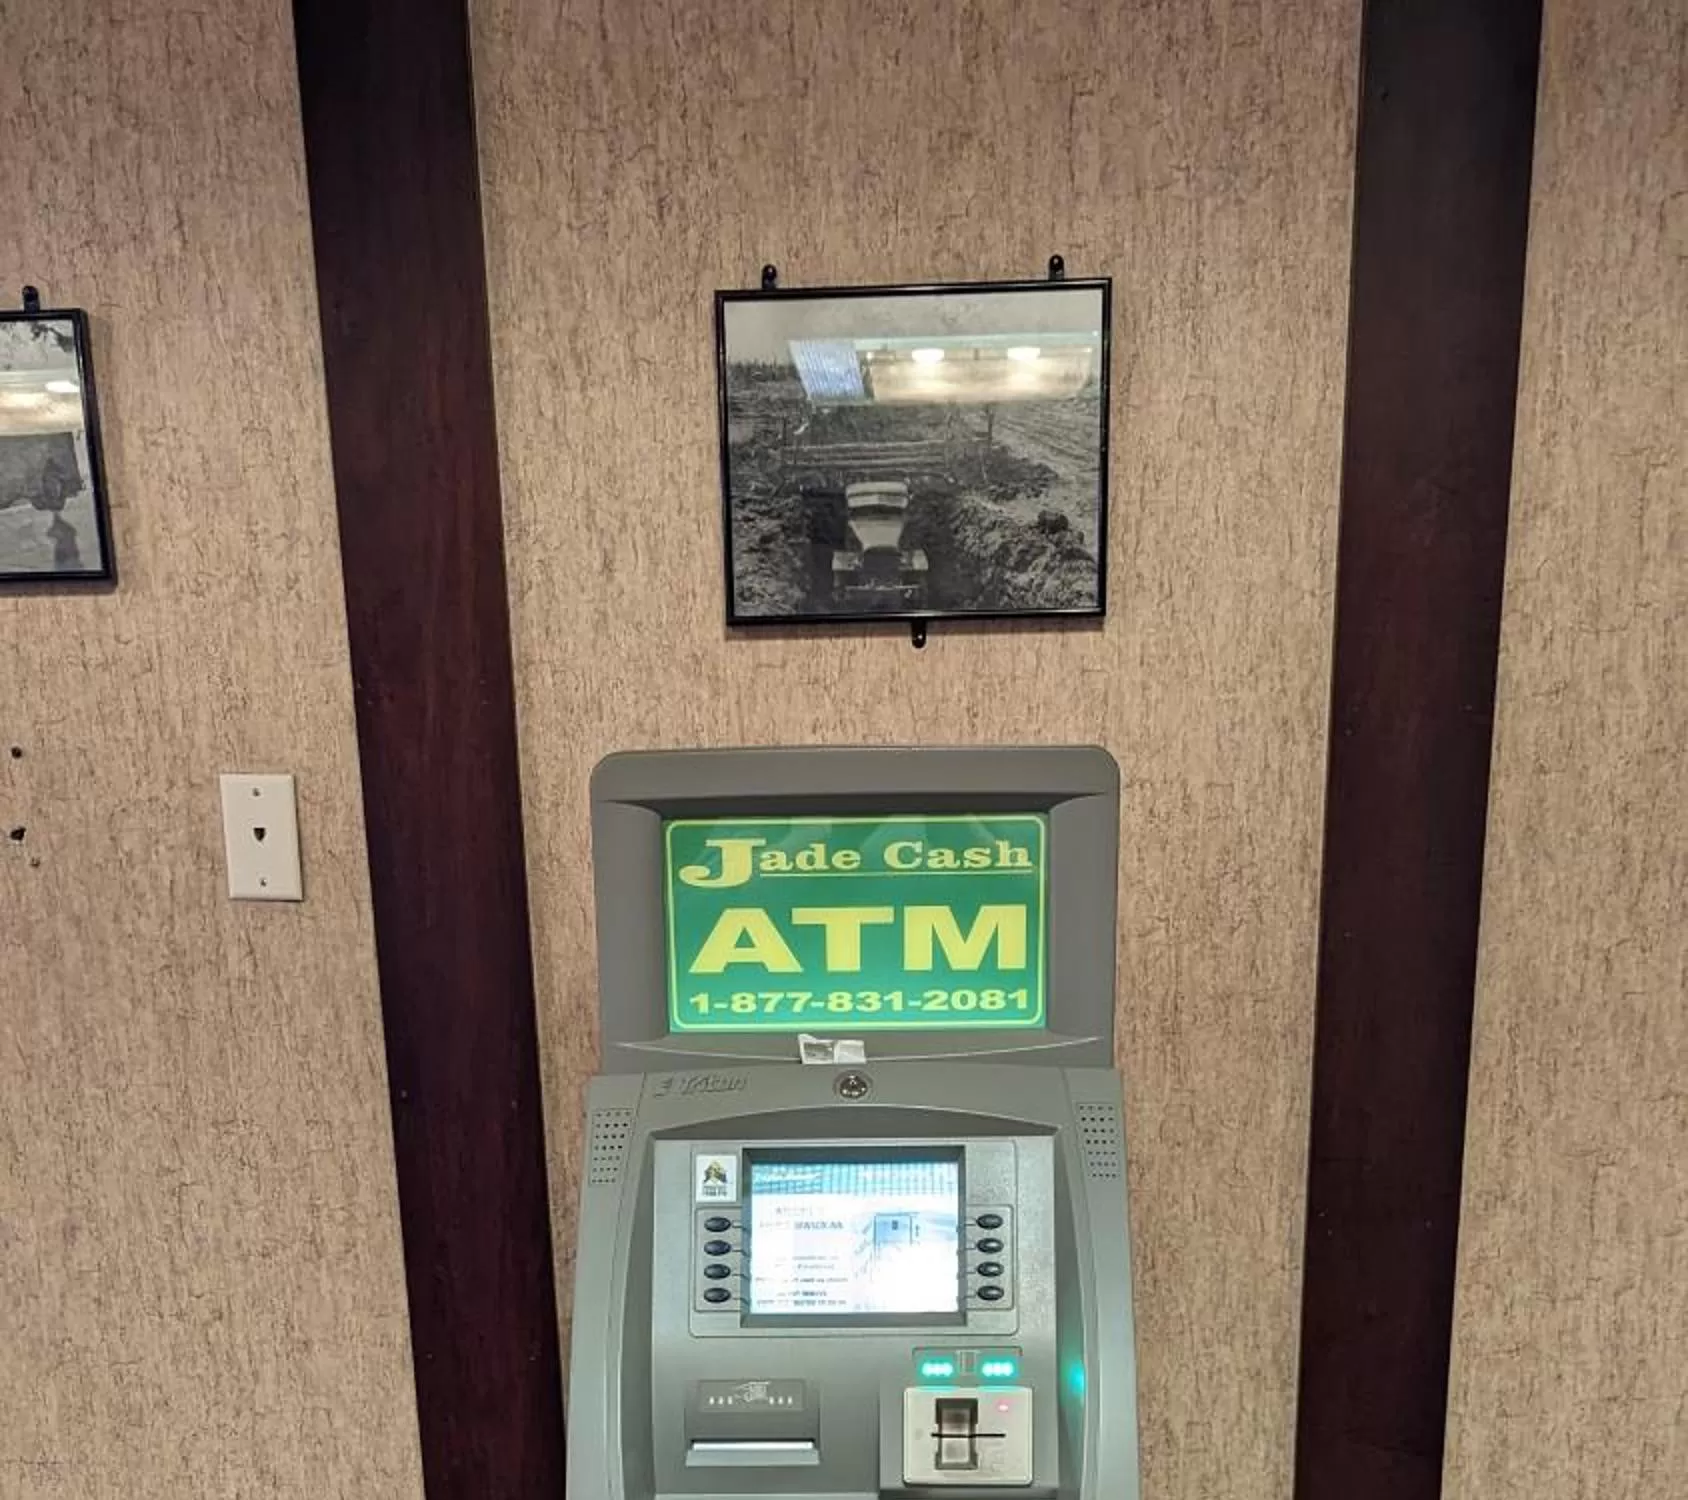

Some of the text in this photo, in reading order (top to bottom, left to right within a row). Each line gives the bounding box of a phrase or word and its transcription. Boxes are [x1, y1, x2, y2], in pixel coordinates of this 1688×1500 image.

[678, 837, 1034, 889] Jade Cash
[688, 904, 1028, 974] ATM
[689, 988, 1029, 1015] 1-877-831-2081
